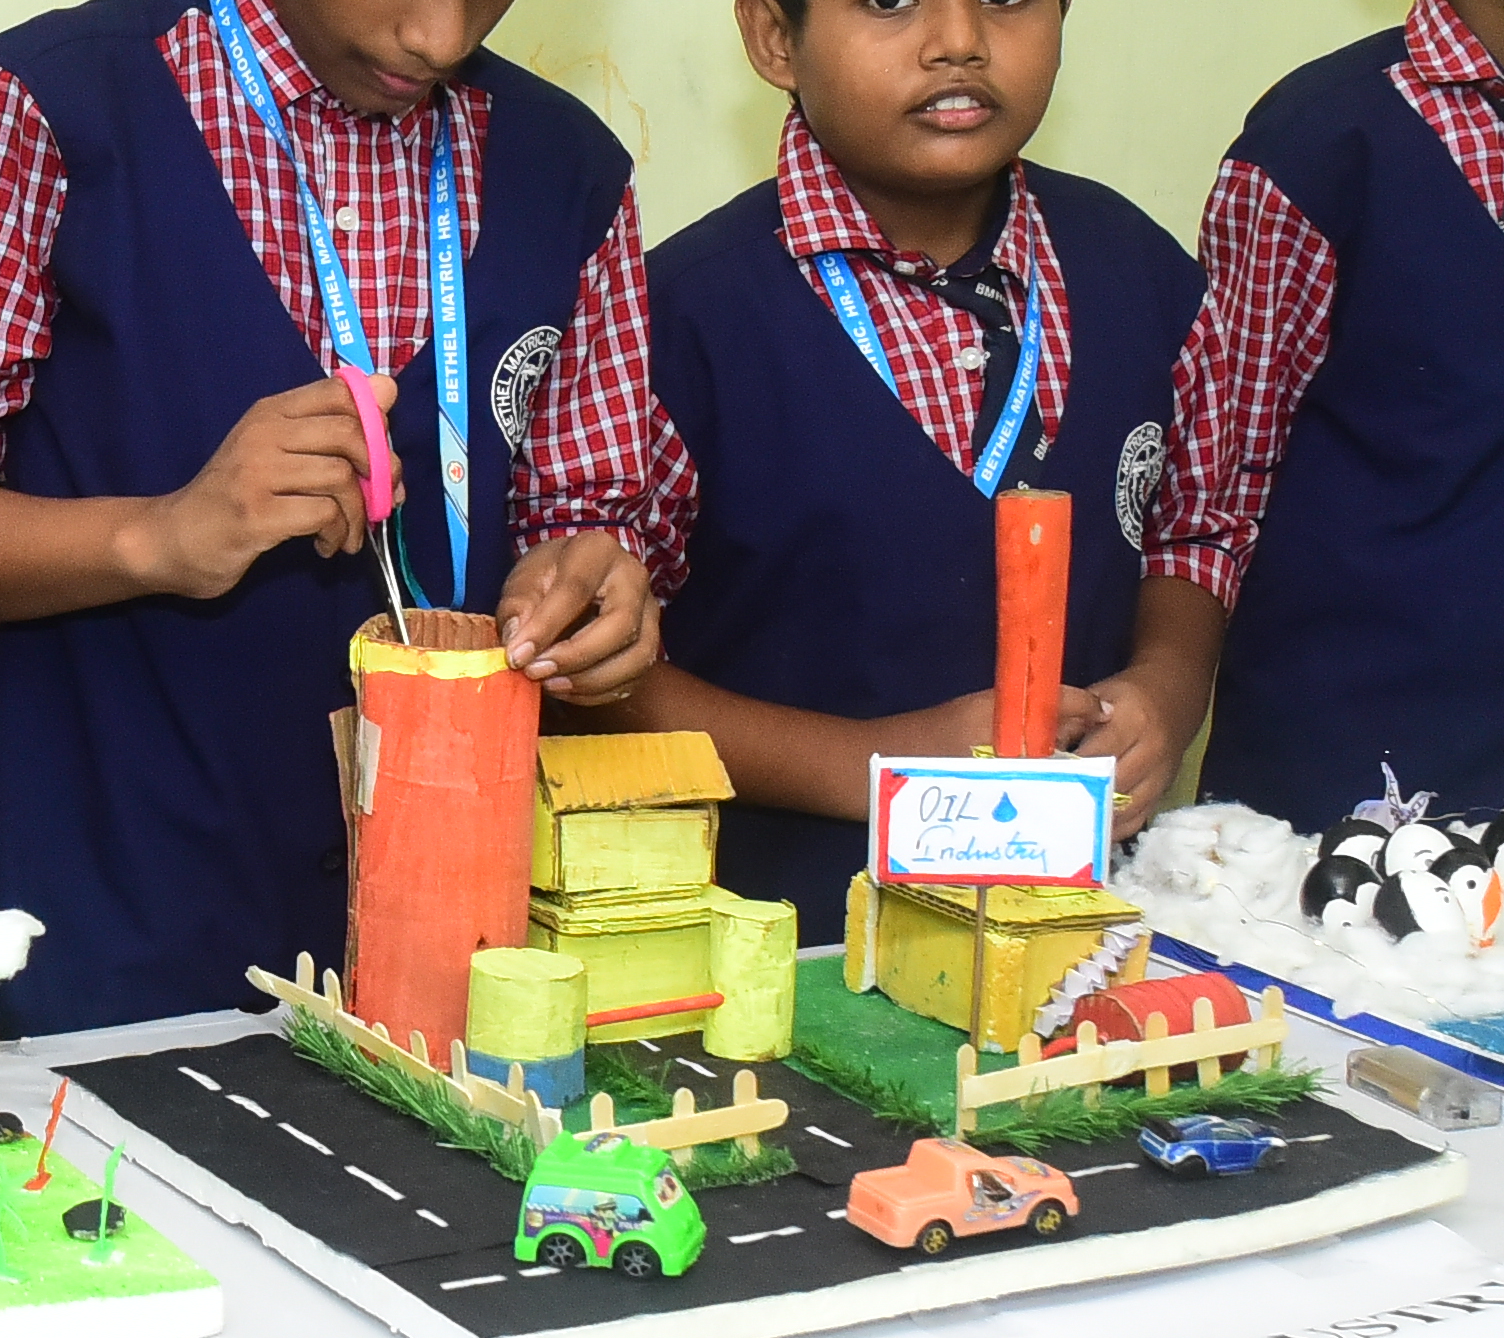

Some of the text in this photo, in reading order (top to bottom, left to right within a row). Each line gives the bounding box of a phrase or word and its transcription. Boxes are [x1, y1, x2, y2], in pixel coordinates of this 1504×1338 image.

[437, 206, 454, 239] HR.
[323, 269, 355, 345] BETHEL
[438, 243, 457, 322] MATRIC.
[438, 327, 459, 404] BETHEL
[981, 417, 1017, 482] BETHEL
[1011, 349, 1036, 414] MATRIC.
[920, 785, 980, 823] OIL
